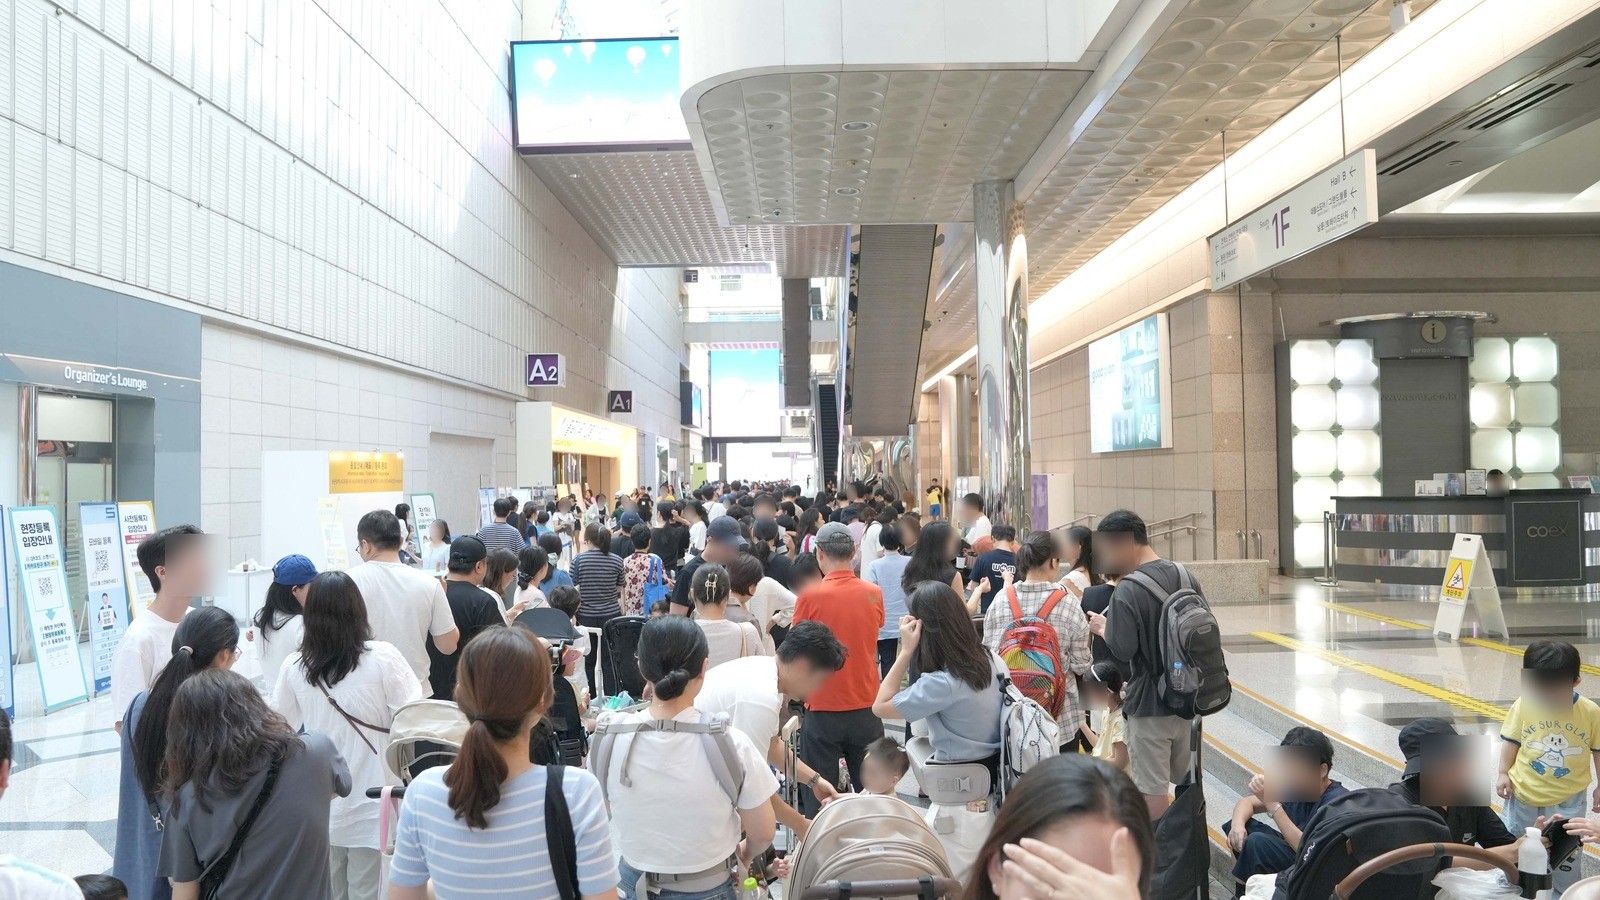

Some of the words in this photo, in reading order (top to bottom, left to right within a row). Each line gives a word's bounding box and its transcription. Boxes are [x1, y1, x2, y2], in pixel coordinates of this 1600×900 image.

[1330, 174, 1341, 187] Hall
[1342, 171, 1347, 181] B
[1271, 206, 1290, 249] 1F
[529, 358, 557, 381] A2
[64, 365, 117, 385] Organizer's
[117, 374, 148, 391] Lounge
[612, 393, 631, 410] A1
[20, 522, 51, 534] 현장등록
[22, 535, 53, 548] 입장안내
[1539, 721, 1561, 730] SUR
